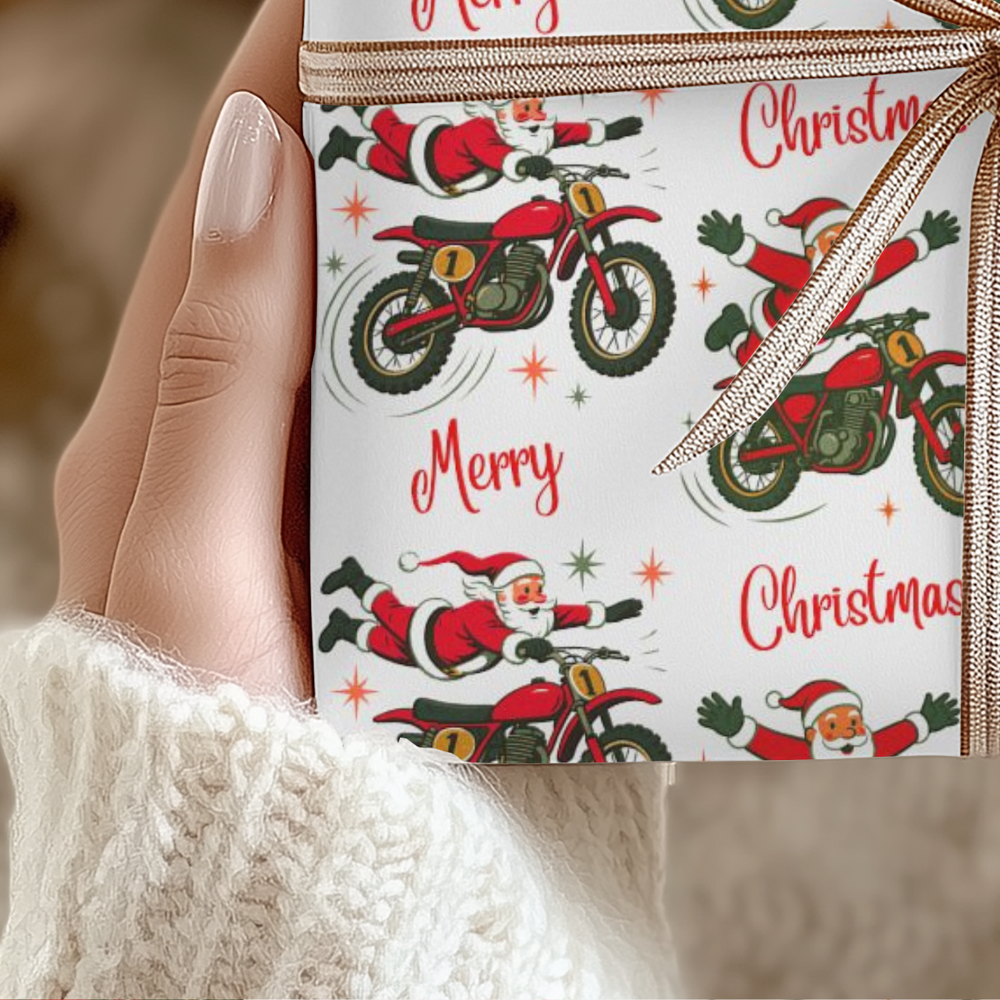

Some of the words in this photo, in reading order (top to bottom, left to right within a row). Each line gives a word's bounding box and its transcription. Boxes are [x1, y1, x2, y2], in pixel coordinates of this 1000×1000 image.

[740, 77, 935, 169] Christm
[579, 186, 596, 214] 1
[446, 250, 459, 277] 1
[897, 334, 919, 362] 1
[411, 417, 564, 517] Merry
[740, 558, 963, 652] Christmas
[579, 669, 596, 697] 1
